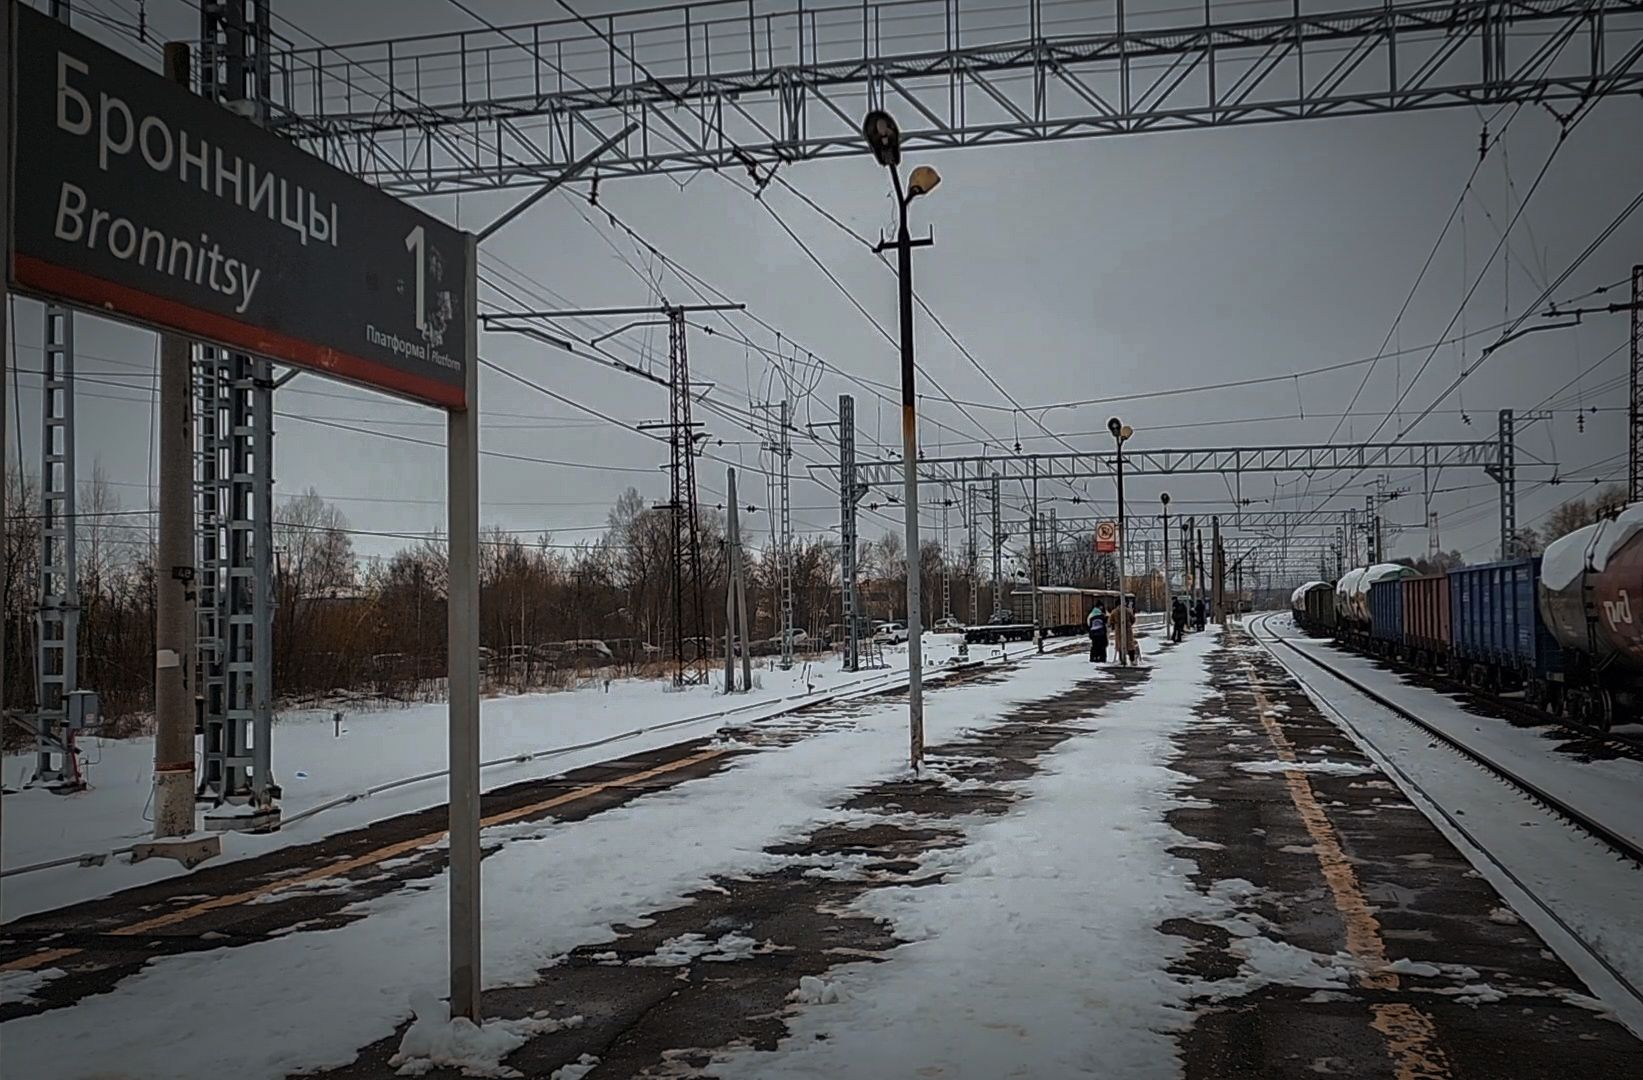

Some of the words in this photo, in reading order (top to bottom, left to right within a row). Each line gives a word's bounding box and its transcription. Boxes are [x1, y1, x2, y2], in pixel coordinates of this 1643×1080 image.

[55, 50, 338, 248] Бронницы
[54, 181, 262, 314] Bronnitsy
[404, 224, 425, 331] 1
[366, 324, 426, 360] Платформа
[431, 349, 461, 372] Platform
